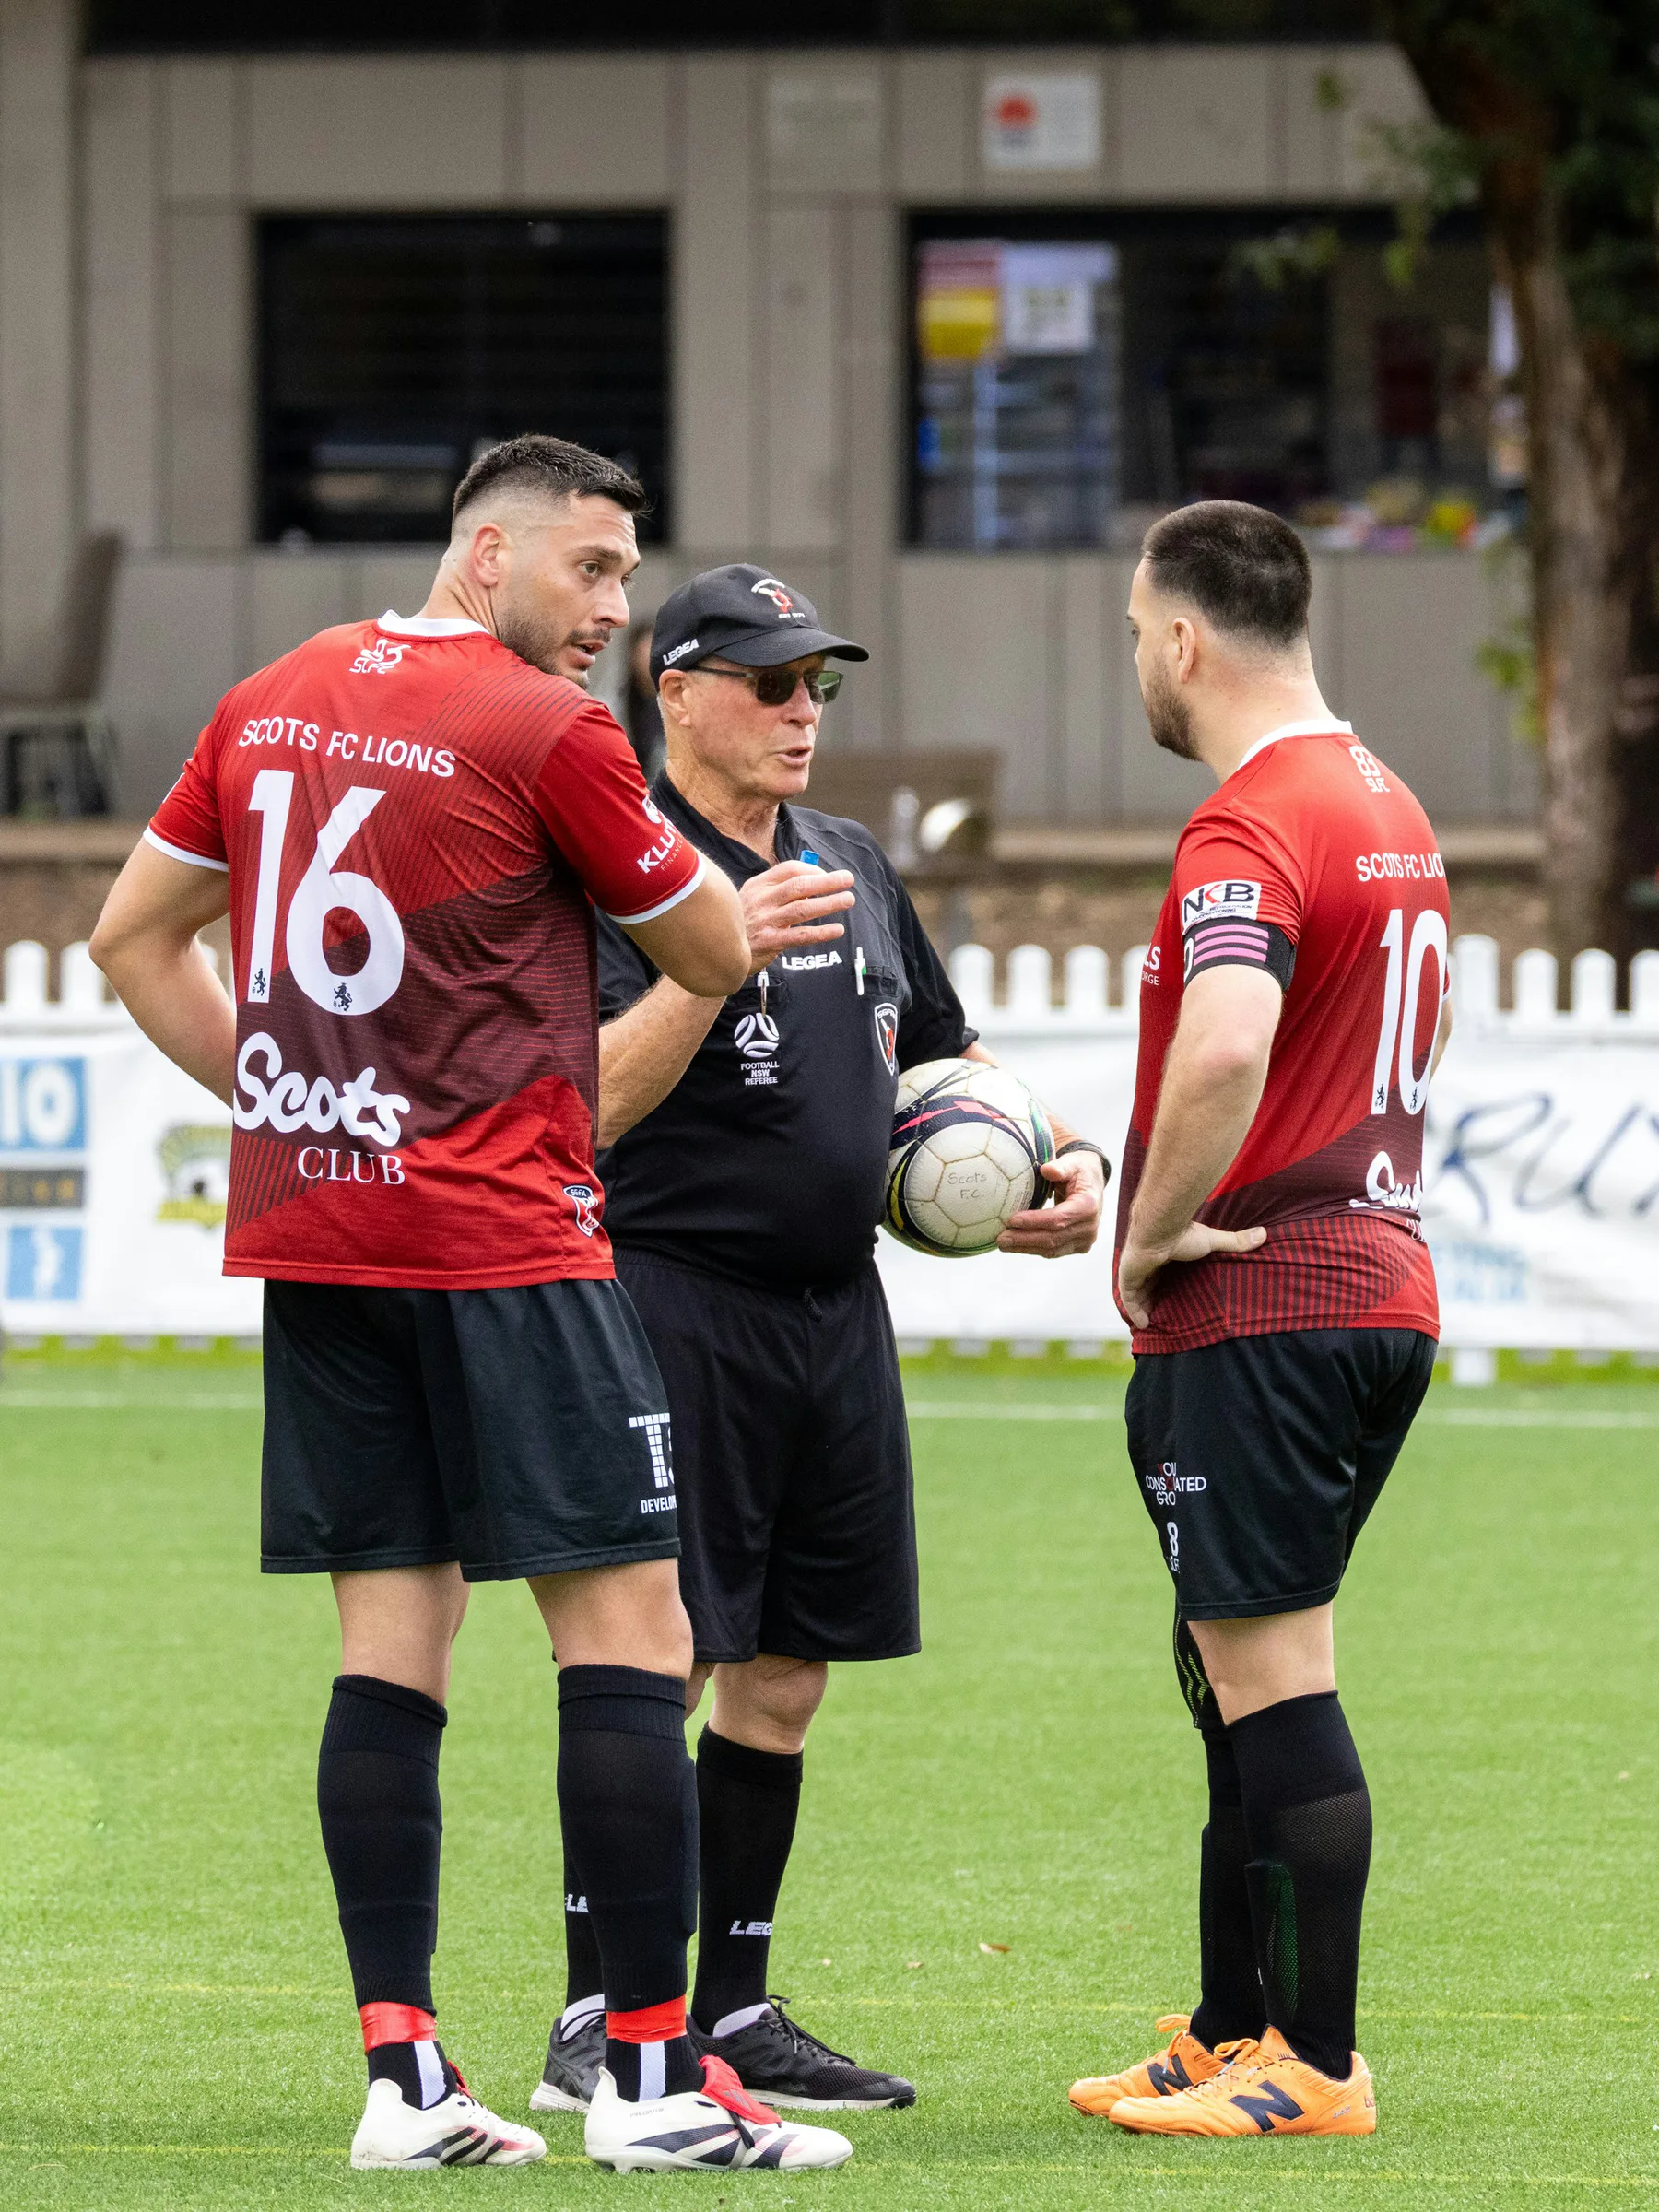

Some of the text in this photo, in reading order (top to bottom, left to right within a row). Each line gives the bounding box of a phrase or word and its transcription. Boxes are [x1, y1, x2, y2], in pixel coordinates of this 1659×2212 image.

[663, 638, 700, 666] LEGEA
[238, 716, 456, 777] SCOTS FC LIONS
[1355, 852, 1446, 882] SCOTS FC LIO
[248, 769, 406, 1016] 16
[1183, 883, 1255, 923] NKB
[782, 950, 843, 971] LEGEA
[1371, 908, 1448, 1116] 10
[740, 1061, 780, 1070] FOOTBALL
[751, 1069, 770, 1077] NSW
[233, 1031, 411, 1147] Scots
[745, 1077, 778, 1086] REFEREE
[297, 1147, 406, 1185] CLUB
[947, 1172, 987, 1185] Scots
